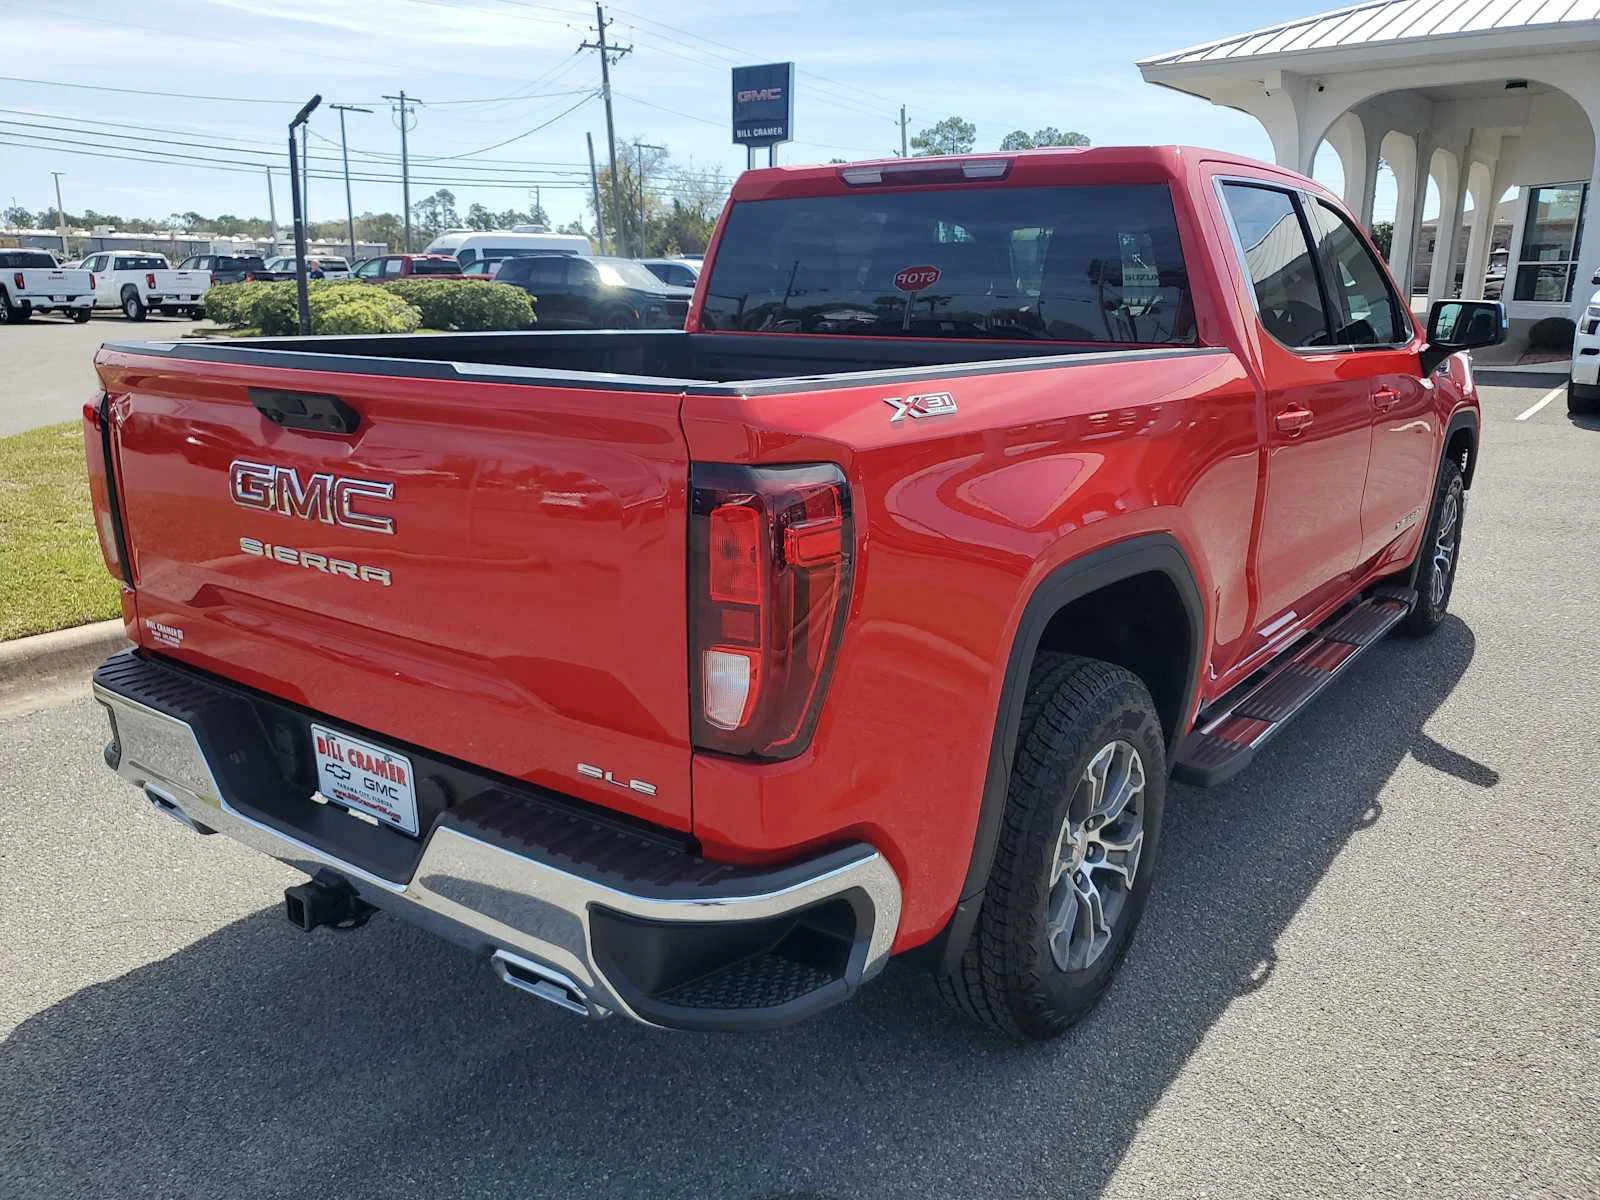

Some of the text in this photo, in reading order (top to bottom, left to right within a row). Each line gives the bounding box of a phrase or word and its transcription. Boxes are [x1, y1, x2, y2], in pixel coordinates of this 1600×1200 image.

[737, 88, 782, 103] GMC
[736, 127, 783, 138] BILL CRAMER
[882, 391, 957, 422] X31
[229, 459, 396, 536] GMC
[239, 537, 393, 587] SIERRA
[316, 736, 407, 787] BILL CRAMER
[363, 777, 400, 801] GMC
[577, 762, 657, 796] SLE
